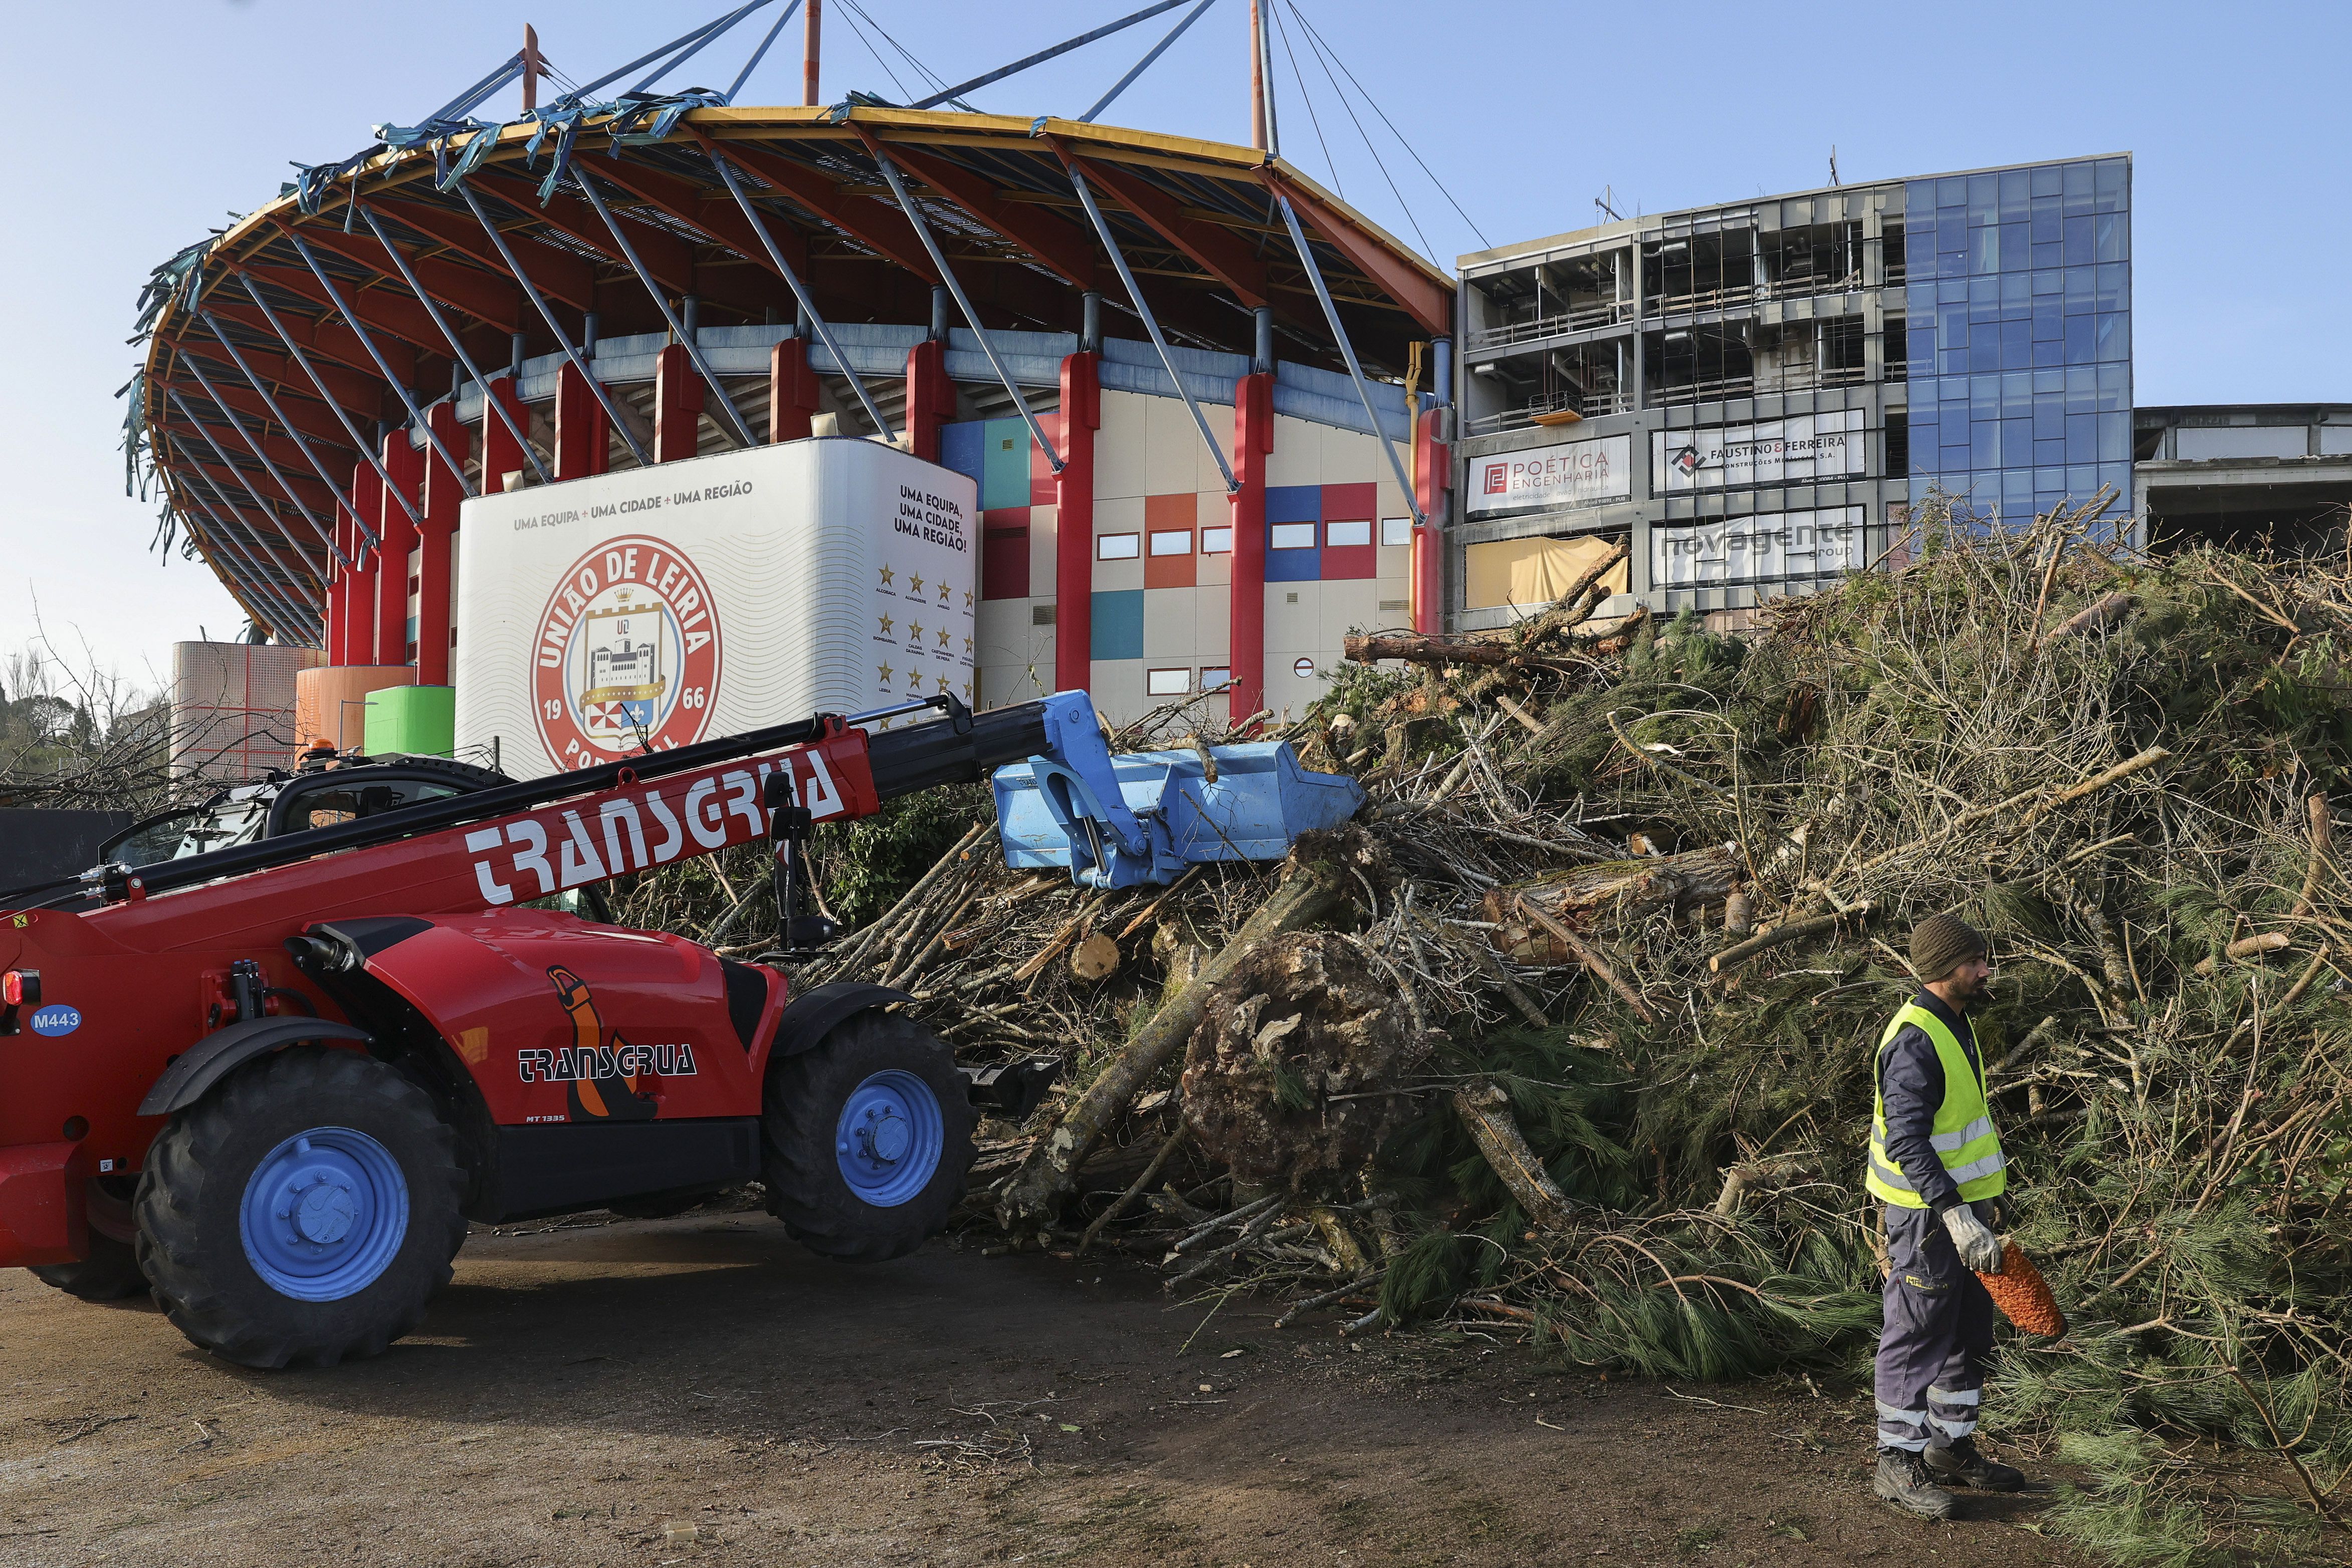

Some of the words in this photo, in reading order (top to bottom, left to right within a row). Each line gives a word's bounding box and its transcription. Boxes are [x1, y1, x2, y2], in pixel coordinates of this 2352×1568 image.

[1710, 443, 1772, 460] FAUSTINO
[1774, 443, 1783, 453] &
[1786, 436, 1845, 452] FERREIRA
[1514, 452, 1609, 478] POÉTICA
[1513, 469, 1609, 489] ENGENHARIA
[514, 517, 538, 531] UMA
[541, 510, 579, 527] EQUIPA
[591, 504, 617, 519] UMA
[620, 496, 662, 514] CIDADE
[674, 490, 701, 505] UMA
[705, 480, 752, 500] REGIÃO
[901, 485, 923, 504] UMA
[926, 494, 963, 520] EQUIPA,
[1513, 492, 1550, 501] eletricidade
[900, 503, 923, 521] UMA
[926, 511, 962, 536] CIDADE,
[895, 517, 920, 538] UMA
[923, 526, 967, 553] REGIÃO!
[1661, 521, 1853, 557] novagente
[1808, 546, 1853, 560] group
[539, 567, 599, 669] UNIÃO
[605, 548, 637, 583] DE
[645, 552, 712, 655] LEIRIA
[873, 636, 898, 645] BOMBARRAL
[543, 699, 562, 721] 19
[682, 687, 705, 710] 66
[34, 1013, 79, 1029] M443
[518, 1044, 697, 1083] TRANSGRUA
